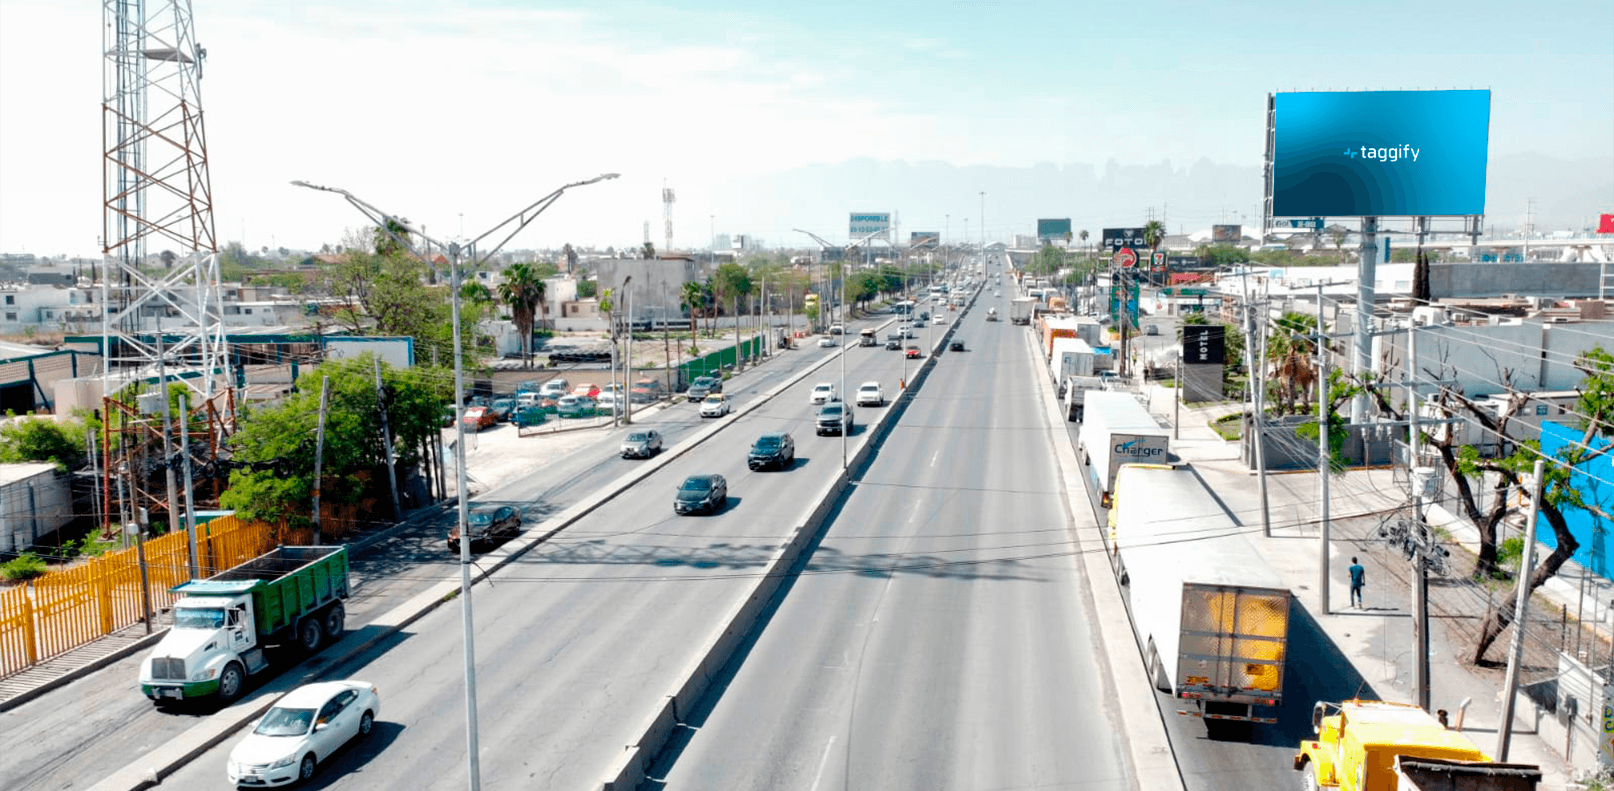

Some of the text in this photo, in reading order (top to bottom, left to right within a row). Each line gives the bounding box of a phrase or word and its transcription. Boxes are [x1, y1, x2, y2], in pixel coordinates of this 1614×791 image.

[1360, 143, 1420, 162] taggify
[1105, 238, 1147, 246] FOTO
[1114, 441, 1163, 457] Charger
